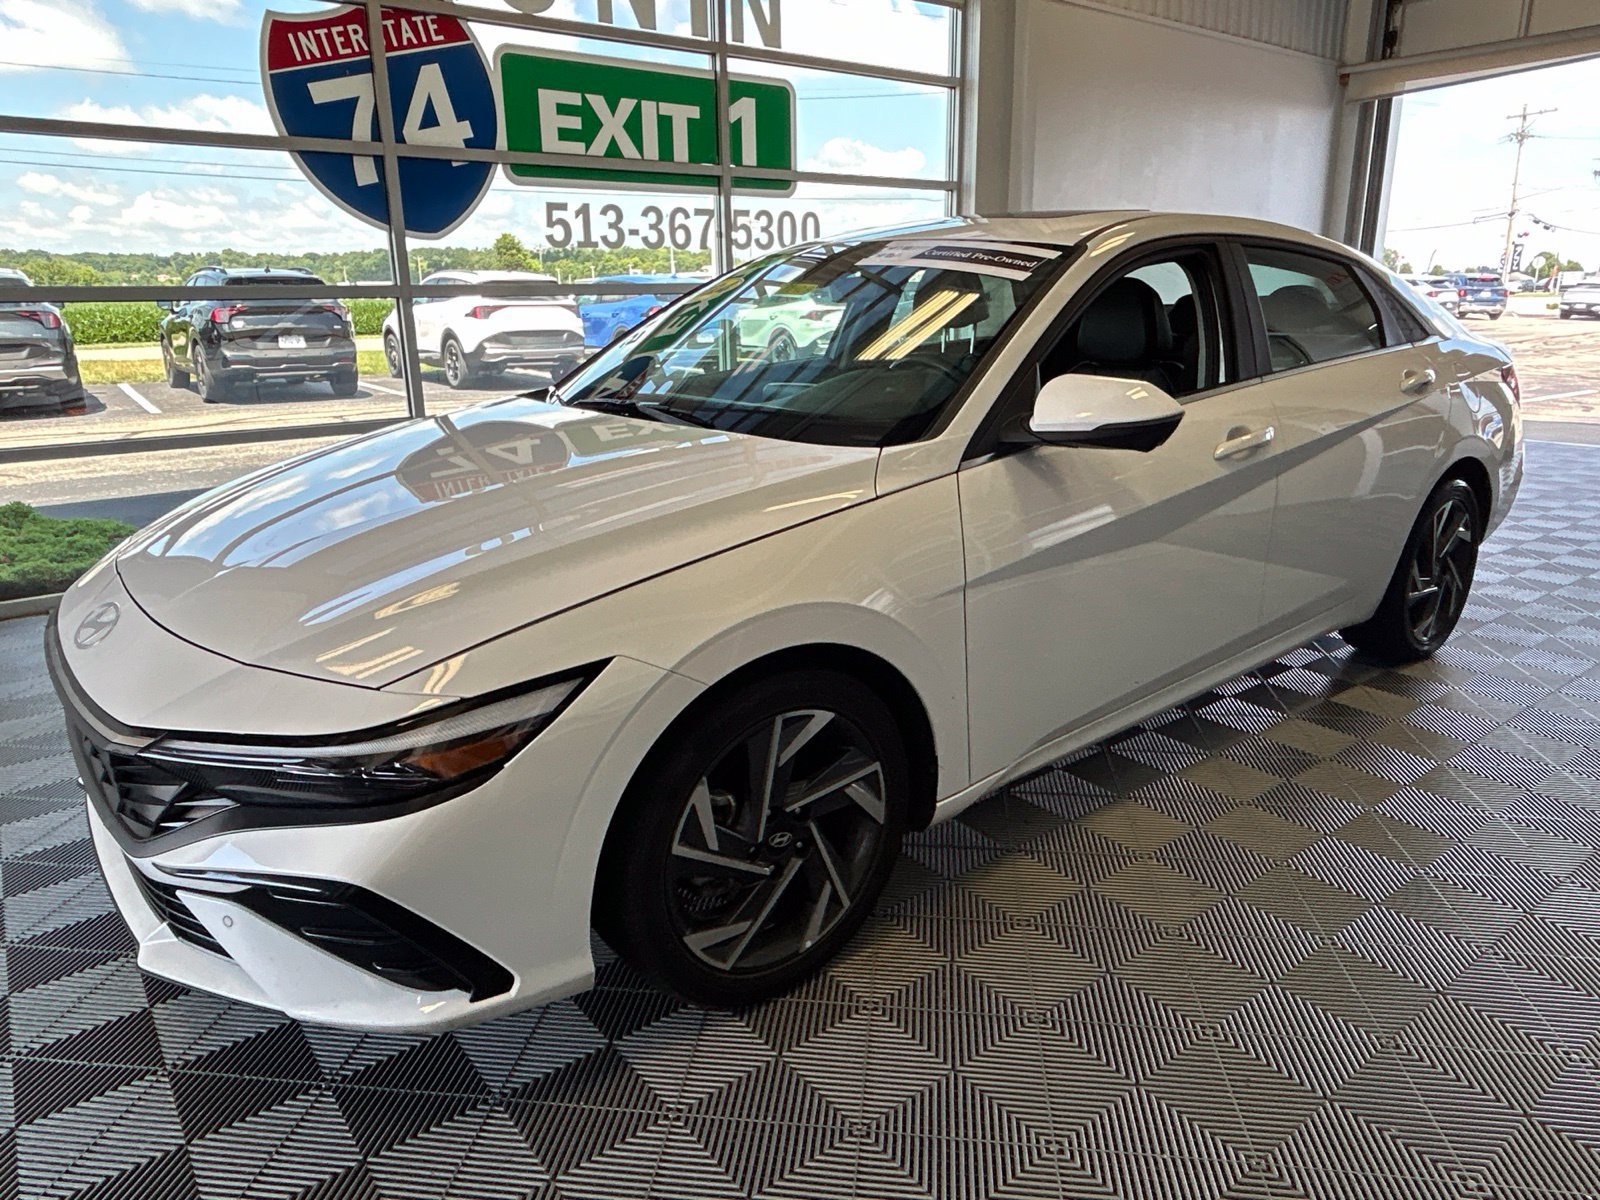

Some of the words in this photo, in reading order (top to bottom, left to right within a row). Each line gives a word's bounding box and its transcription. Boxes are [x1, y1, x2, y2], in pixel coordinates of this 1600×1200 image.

[288, 15, 444, 62] INTERTATE
[307, 62, 474, 187] 74
[537, 88, 700, 163] EXIT
[728, 96, 758, 167] 1
[544, 201, 821, 250] 513-3675300
[924, 250, 971, 258] Certified
[971, 253, 1038, 268] Pre-Owned
